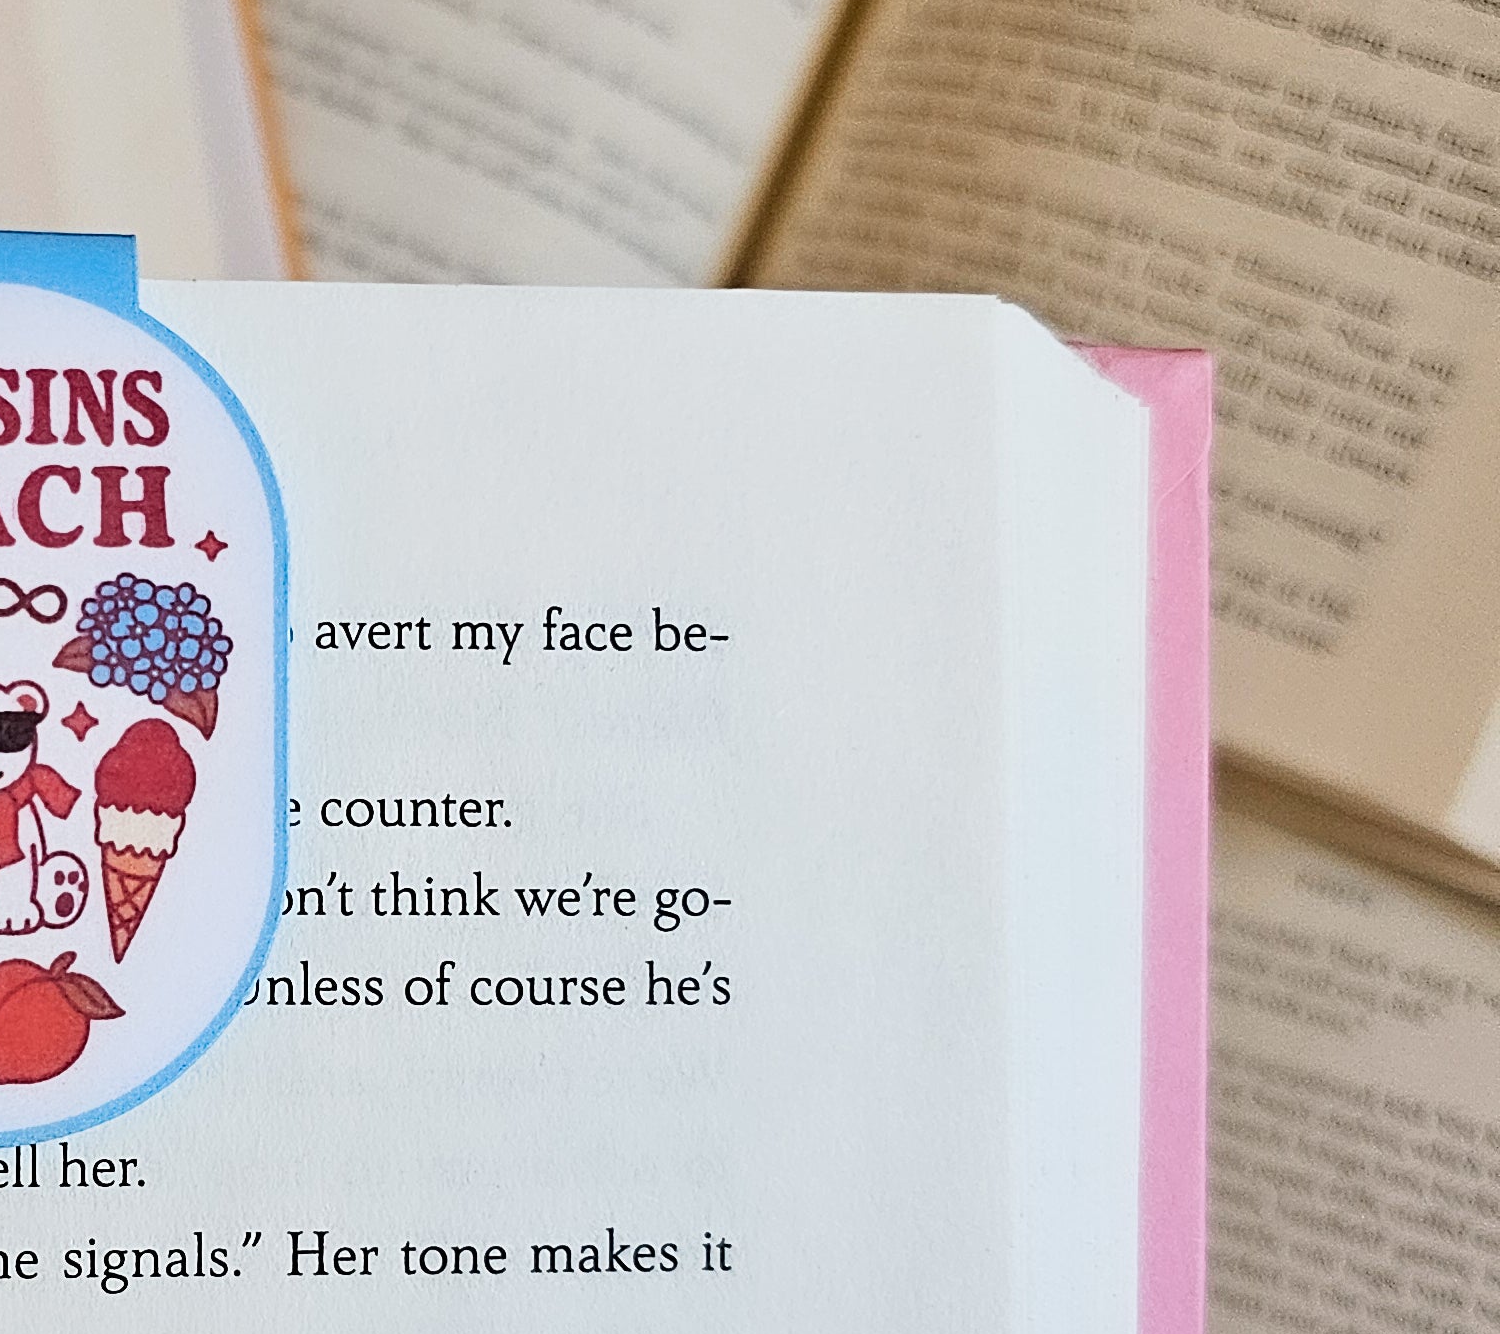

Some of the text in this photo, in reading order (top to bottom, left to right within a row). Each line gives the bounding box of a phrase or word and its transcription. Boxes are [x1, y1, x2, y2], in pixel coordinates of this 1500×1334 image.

[315, 605, 730, 666] avert my face be-
[320, 793, 512, 828] counter.
[370, 870, 732, 933] think we’re go-
[404, 960, 456, 1006] of
[470, 976, 626, 1007] course
[644, 959, 731, 1006] he’s
[58, 1141, 146, 1188] her.
[63, 1231, 262, 1295] signals.”
[286, 1230, 379, 1277] Her
[400, 1240, 507, 1276] tone
[530, 1226, 679, 1274] makes
[701, 1231, 733, 1272] it
